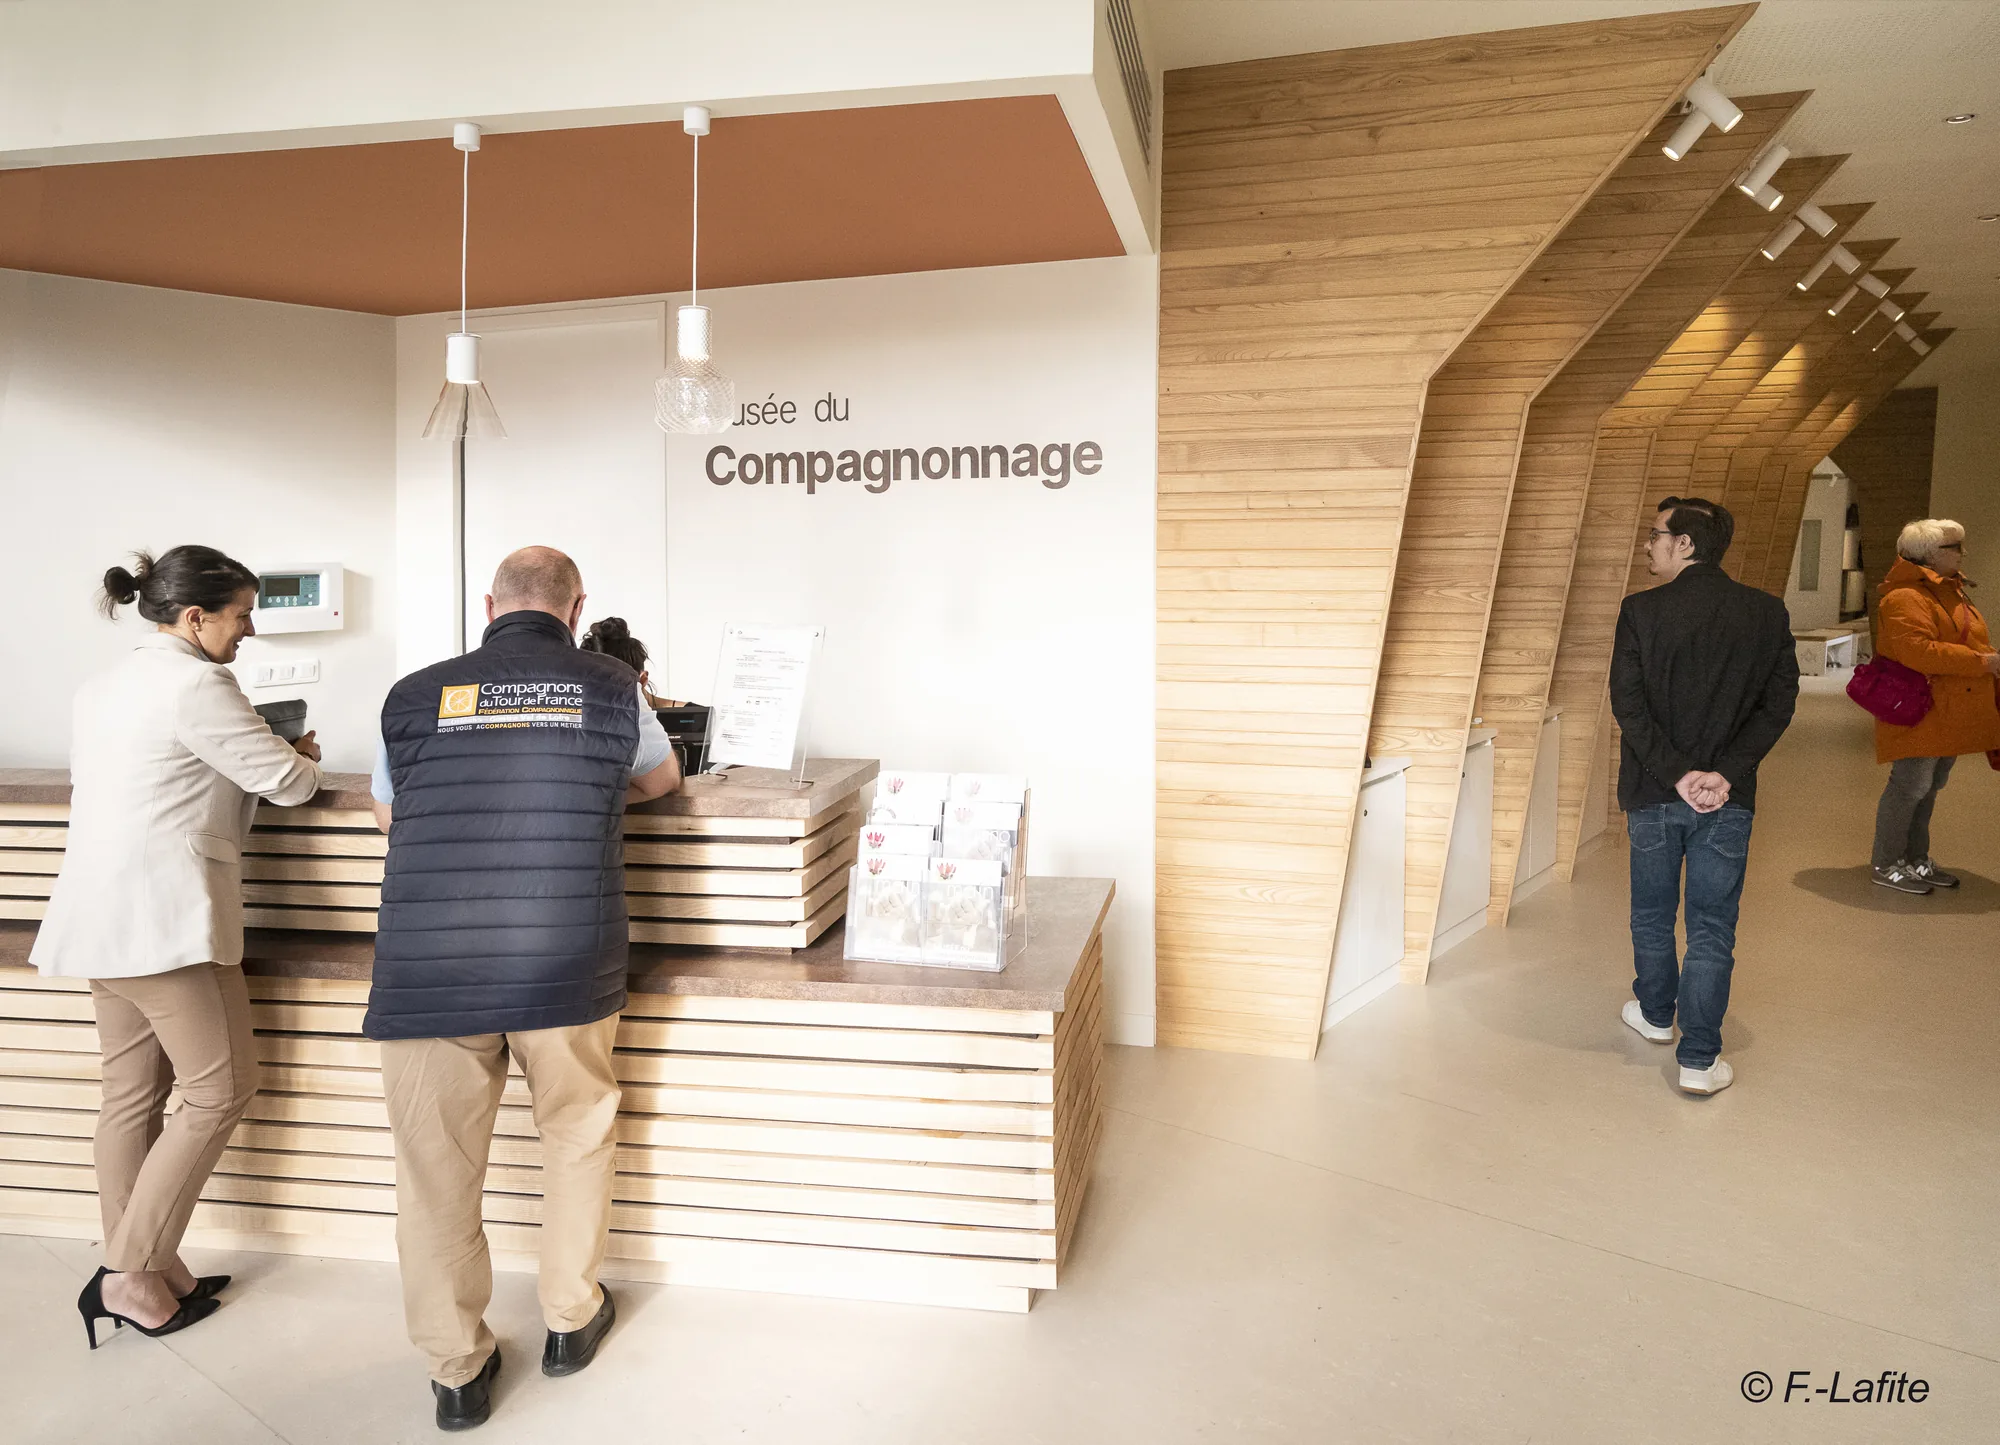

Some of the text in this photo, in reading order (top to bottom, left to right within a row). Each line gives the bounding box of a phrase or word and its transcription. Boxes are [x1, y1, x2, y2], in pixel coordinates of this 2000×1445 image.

[730, 391, 849, 427] usée du
[705, 440, 1104, 495] Compagnonnage
[480, 683, 583, 697] Compagnons
[437, 726, 455, 734] NOUS
[456, 724, 473, 732] VOUS
[476, 721, 531, 730] ACCOMPAGNONS
